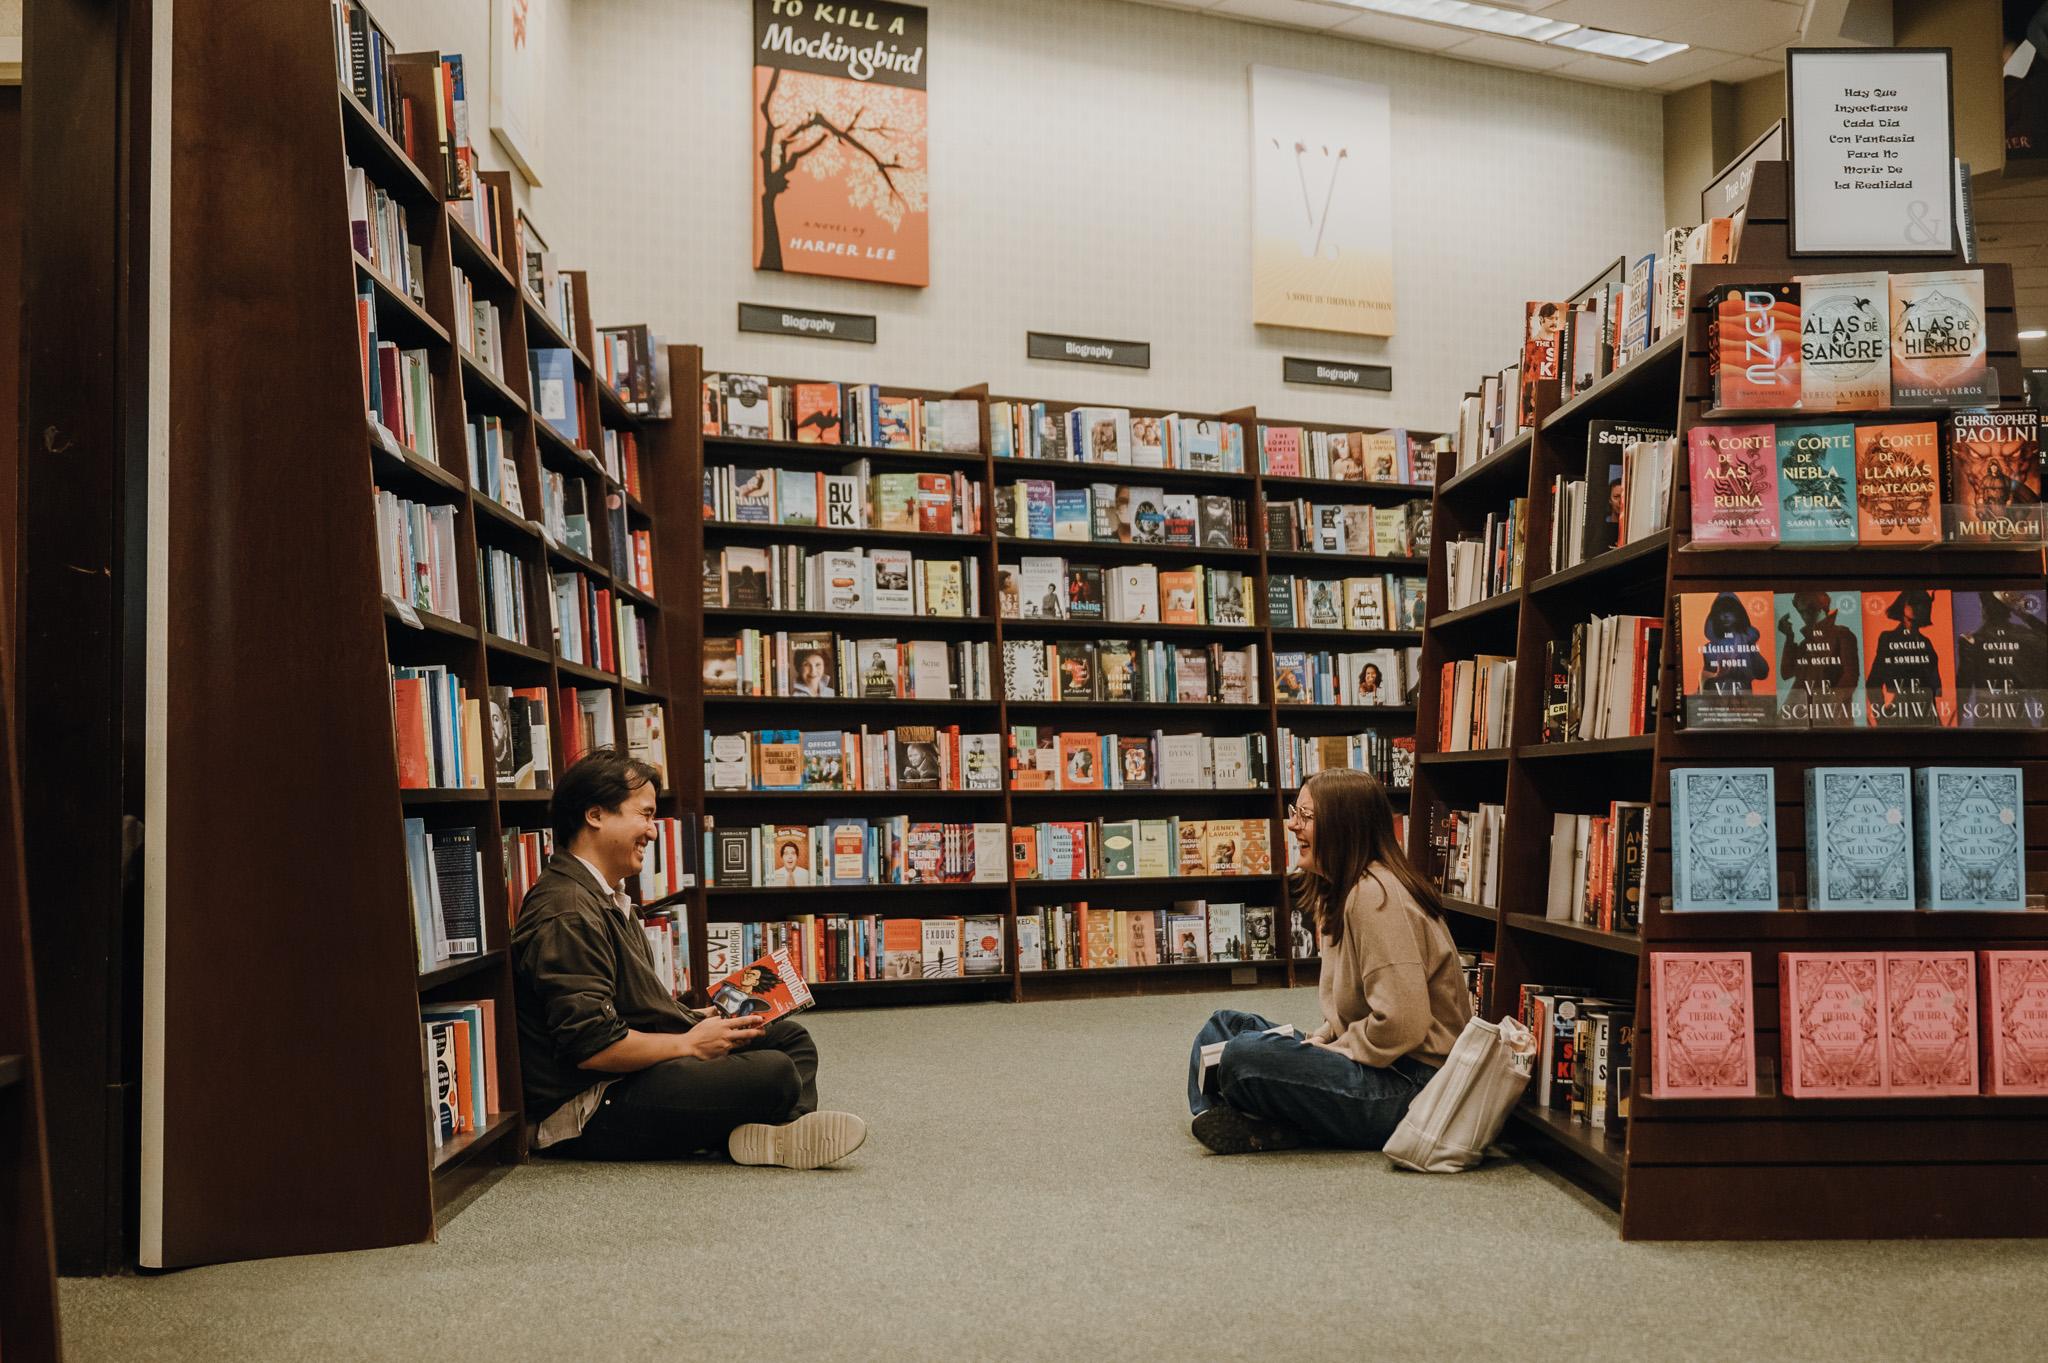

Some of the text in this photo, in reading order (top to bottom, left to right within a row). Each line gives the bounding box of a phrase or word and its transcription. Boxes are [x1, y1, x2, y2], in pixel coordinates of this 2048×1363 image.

[772, 0, 904, 36] TO KILL A
[762, 23, 923, 80] Mockingbird
[1844, 88, 1897, 98] Hay Que
[1834, 104, 1908, 114] Inyectarse
[1843, 119, 1874, 128] Cada
[1829, 134, 1851, 144] Con
[1847, 150, 1898, 159] Para No
[1844, 165, 1903, 174] Morir De
[1834, 180, 1913, 190] La Realidad
[790, 237, 897, 261] HARPER LEE
[1326, 295, 1357, 307] THOMAS
[782, 314, 836, 333] Biography
[1803, 315, 1878, 335] ALAS DE
[1904, 315, 1970, 334] ALAS DE
[1066, 342, 1113, 359] Biography
[1801, 340, 1882, 360] SANGRE
[1905, 336, 1971, 355] HIERRO
[1316, 366, 1359, 383] Biography
[1898, 387, 1983, 397] REBECCA YARROS
[1954, 414, 2037, 427] CHRISTOPHER
[1627, 426, 1669, 435] ENCYCLOPEDIA
[1956, 426, 2037, 443] PAOLINI
[1599, 431, 1642, 446] Serial
[1719, 436, 1773, 450] CORTE
[1798, 436, 1851, 449] CORTE
[1880, 434, 1934, 448] CORTE
[1718, 454, 1732, 462] DE
[1797, 454, 1812, 462] DE
[1879, 452, 1895, 461] DE
[1704, 466, 1748, 480] ALAS
[1783, 466, 1840, 480] NIEBLA
[1864, 464, 1932, 479] LLAMAS
[1744, 482, 1752, 491] Y
[1823, 482, 1832, 491] Y
[1862, 482, 1936, 495] PLATEADAS
[829, 482, 853, 503] BU
[736, 497, 769, 506] MADAM
[1714, 495, 1762, 508] RUINA
[1794, 495, 1841, 508] FURIA
[830, 504, 856, 526] CK
[1960, 518, 2040, 538] MURTAGH
[1071, 601, 1101, 613] Rising
[791, 640, 812, 651] LAURA
[1737, 643, 1760, 653] HILOS
[1806, 642, 1830, 651] MAGIA
[1889, 641, 1926, 650] CONCILIO
[1983, 642, 2019, 651] CONJURO
[1721, 659, 1747, 668] PODER
[1811, 656, 1841, 665] OSCURA
[1894, 655, 1930, 664] SOMBRAS
[1998, 656, 2014, 665] LUZ
[1893, 678, 1925, 694] V. E.
[1782, 702, 1862, 720] SCHWAB
[1870, 702, 1951, 719] SCHWAB
[1962, 701, 2045, 719] SCHWAB
[808, 740, 837, 748] OFFICER
[970, 779, 997, 789] Davis
[1394, 777, 1410, 787] POE
[454, 835, 470, 843] YOGA
[909, 832, 941, 841] UNTAMED
[914, 860, 936, 870] DOYLE
[1210, 862, 1241, 870] BROKEN
[926, 930, 955, 939] EXODUS
[730, 928, 740, 967] WARRIOR
